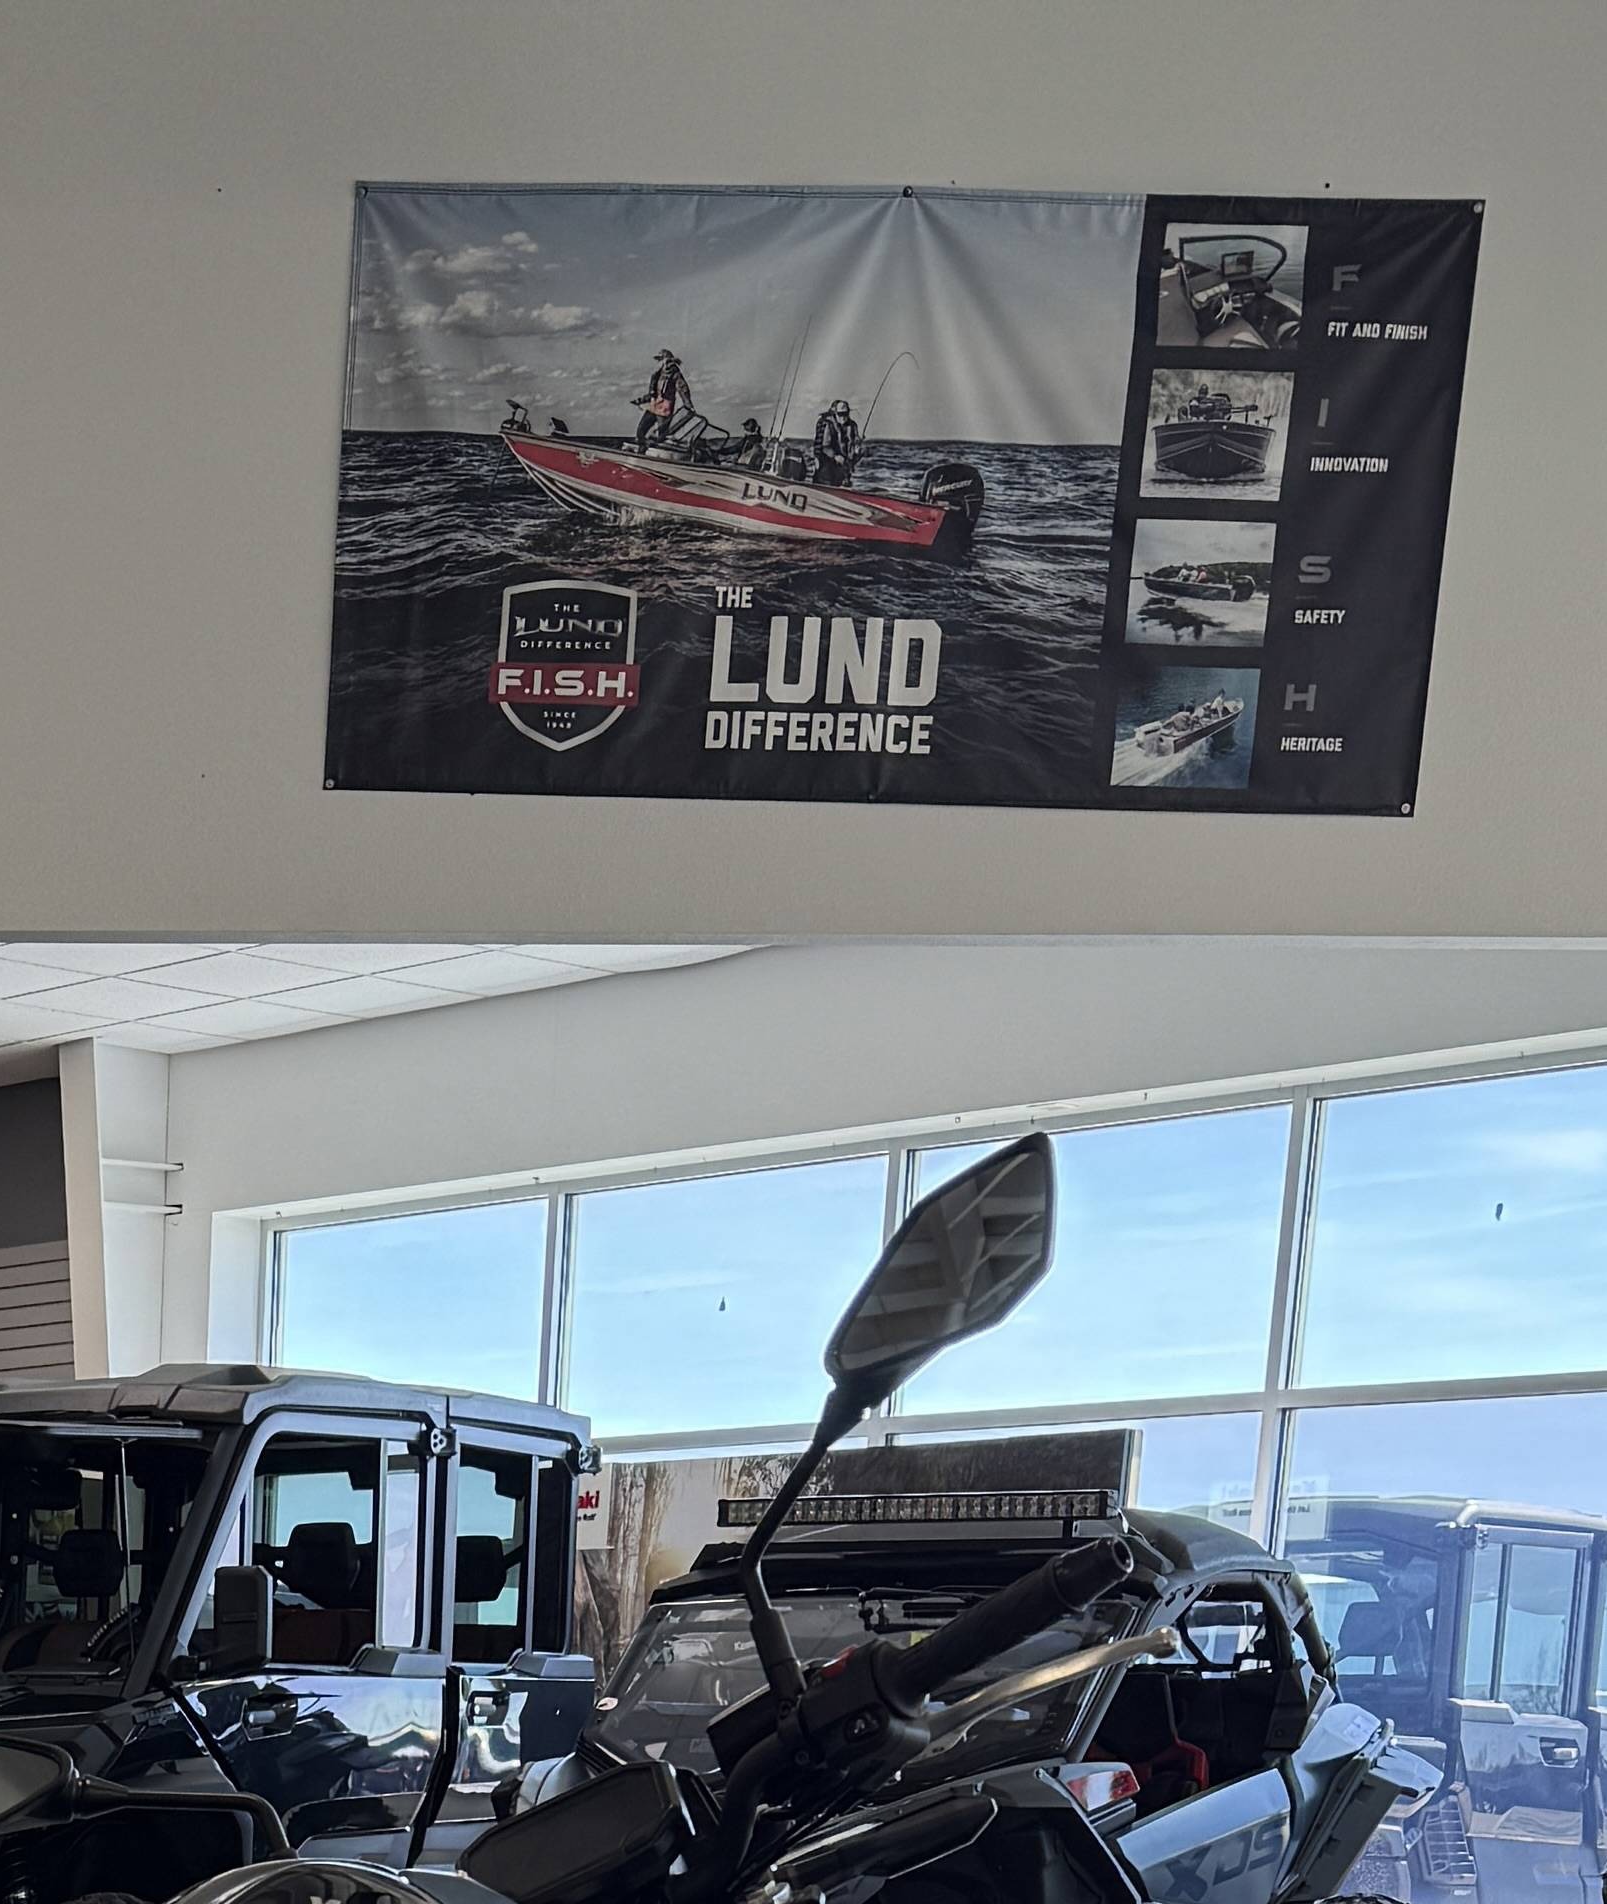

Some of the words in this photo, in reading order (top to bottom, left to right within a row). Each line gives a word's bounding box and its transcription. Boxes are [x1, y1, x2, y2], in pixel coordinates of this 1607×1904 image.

[1331, 263, 1363, 292] F
[1327, 321, 1349, 337] FIT
[1352, 322, 1381, 339] AND
[1384, 323, 1428, 340] FINISH
[1310, 456, 1389, 473] INNOVATION
[742, 482, 808, 513] LUND
[1297, 555, 1332, 584] S
[553, 603, 581, 613] THE
[715, 586, 754, 609] THE
[513, 615, 624, 638] LUND
[1294, 609, 1346, 624] SAFETY
[520, 640, 611, 650] DIFFERENCE
[709, 615, 942, 707] LUND
[497, 668, 634, 699] F.I.S.H.
[1283, 683, 1317, 712] H
[543, 711, 577, 719] SINCE
[704, 711, 934, 754] DIFFERENCE
[1280, 736, 1343, 752] HERITAGE
